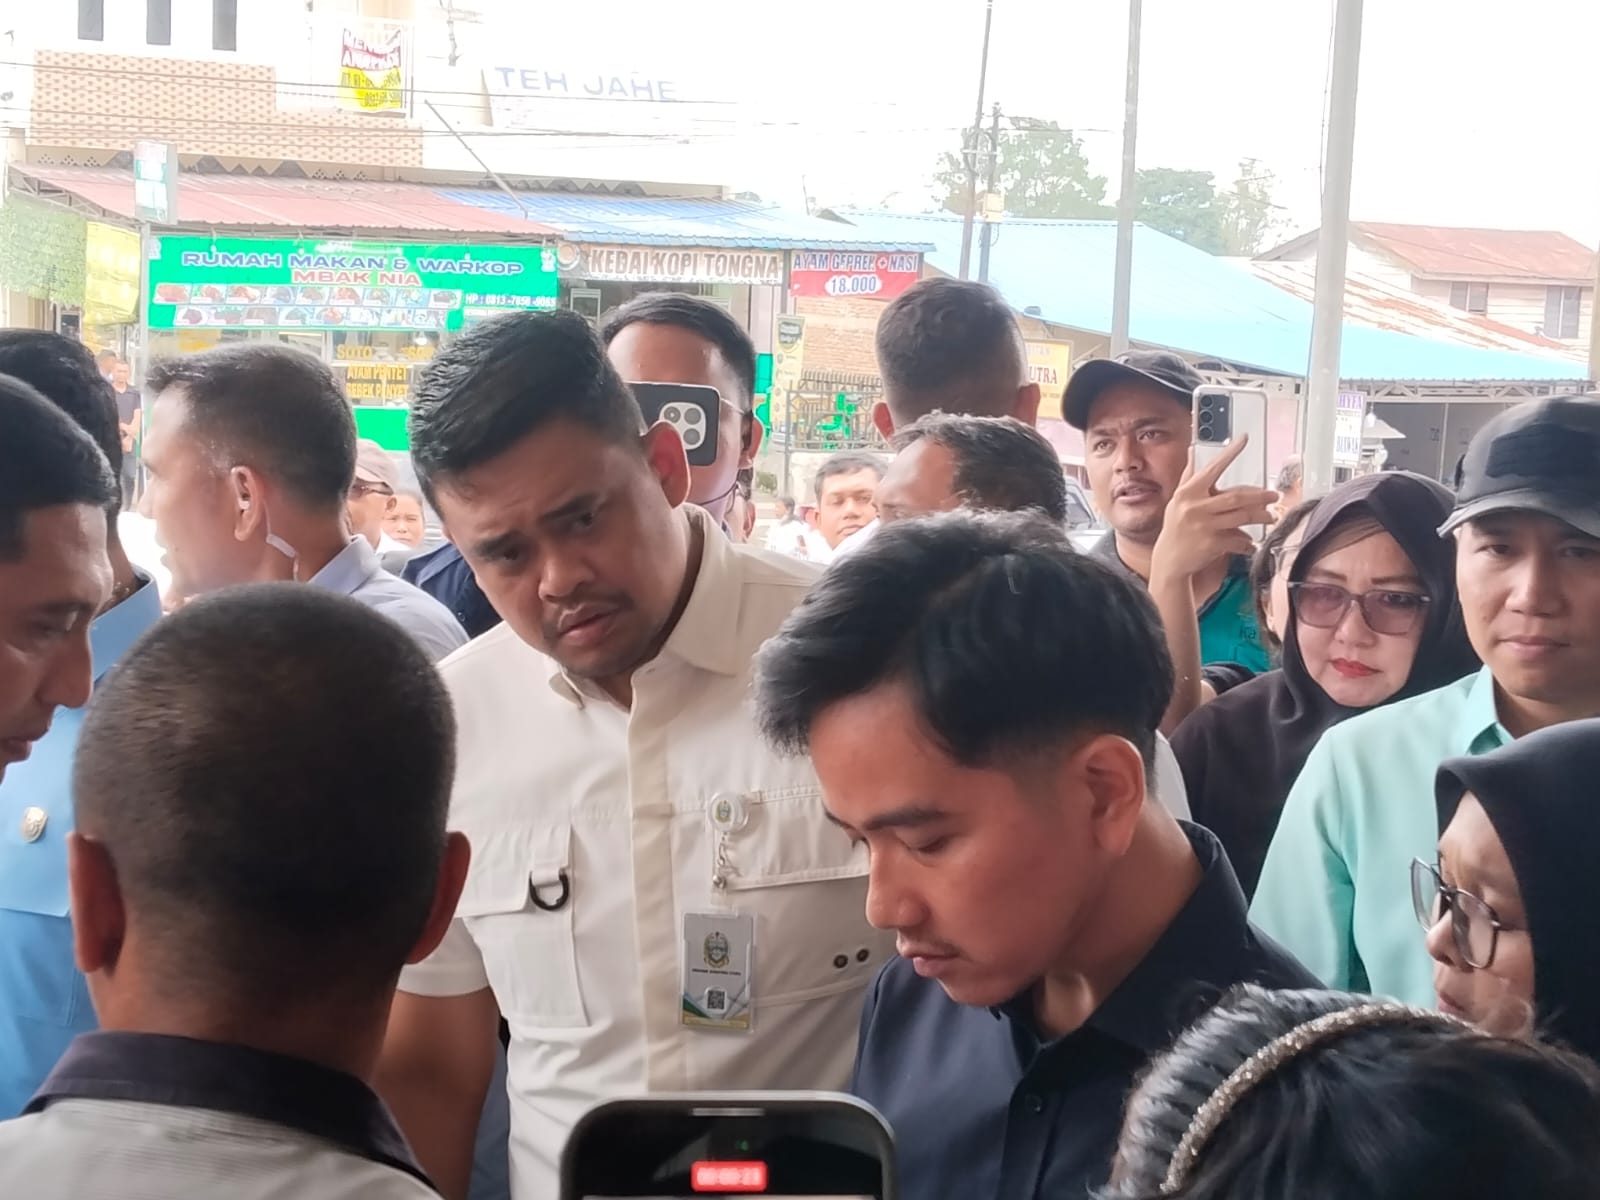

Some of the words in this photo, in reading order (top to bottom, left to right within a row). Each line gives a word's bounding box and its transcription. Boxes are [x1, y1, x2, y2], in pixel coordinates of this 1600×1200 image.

[494, 66, 568, 92] TEH
[583, 75, 677, 103] JAHE
[182, 252, 282, 267] RUMAH
[289, 254, 385, 270] MAKAN
[393, 256, 409, 270] &
[417, 258, 523, 275] WARKOP
[652, 251, 698, 276] KOPI
[793, 253, 829, 270] AYAM
[888, 255, 918, 271] NASI
[293, 270, 369, 285] MBAK
[379, 272, 421, 286] NIA
[831, 276, 877, 293] 18.000
[465, 293, 479, 305] HP
